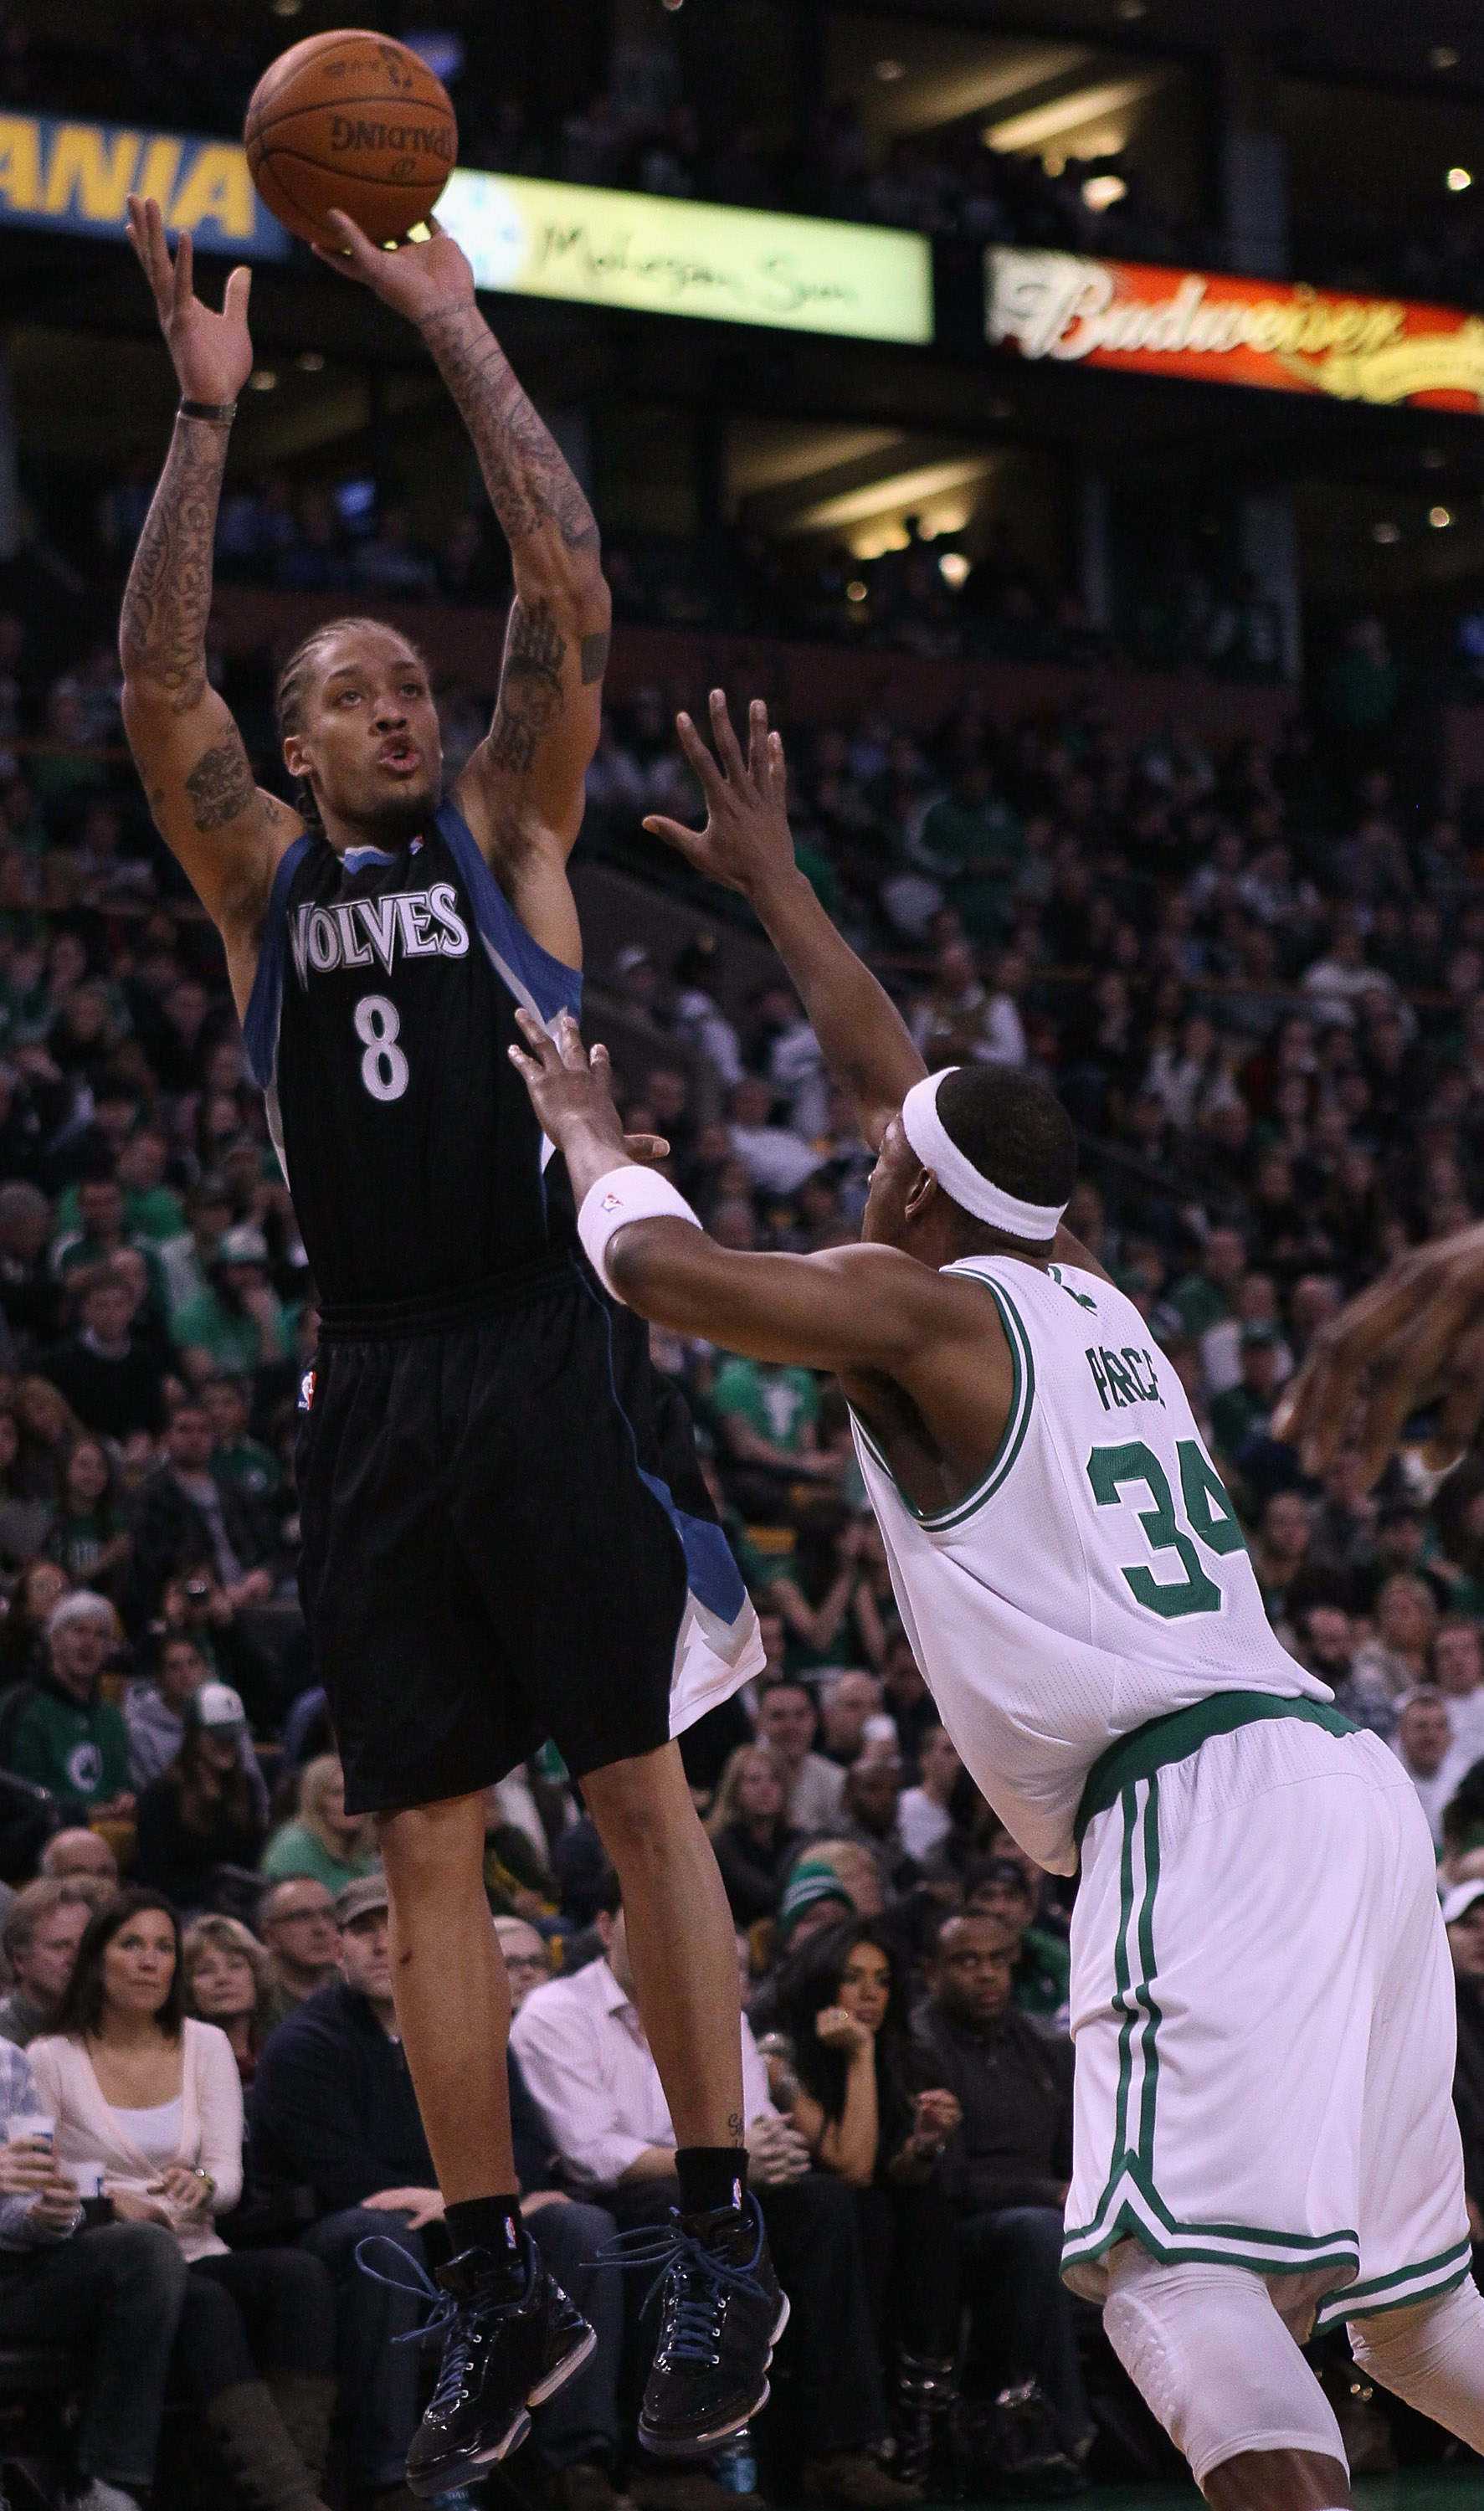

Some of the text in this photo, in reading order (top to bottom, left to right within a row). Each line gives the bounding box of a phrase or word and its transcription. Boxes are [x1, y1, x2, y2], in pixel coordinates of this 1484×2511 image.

[331, 114, 453, 162] PALDING
[988, 249, 1408, 361] Budweiser
[353, 994, 410, 1102] 8
[1085, 1346, 1168, 1412] PRC
[1086, 1440, 1248, 1620] 34
